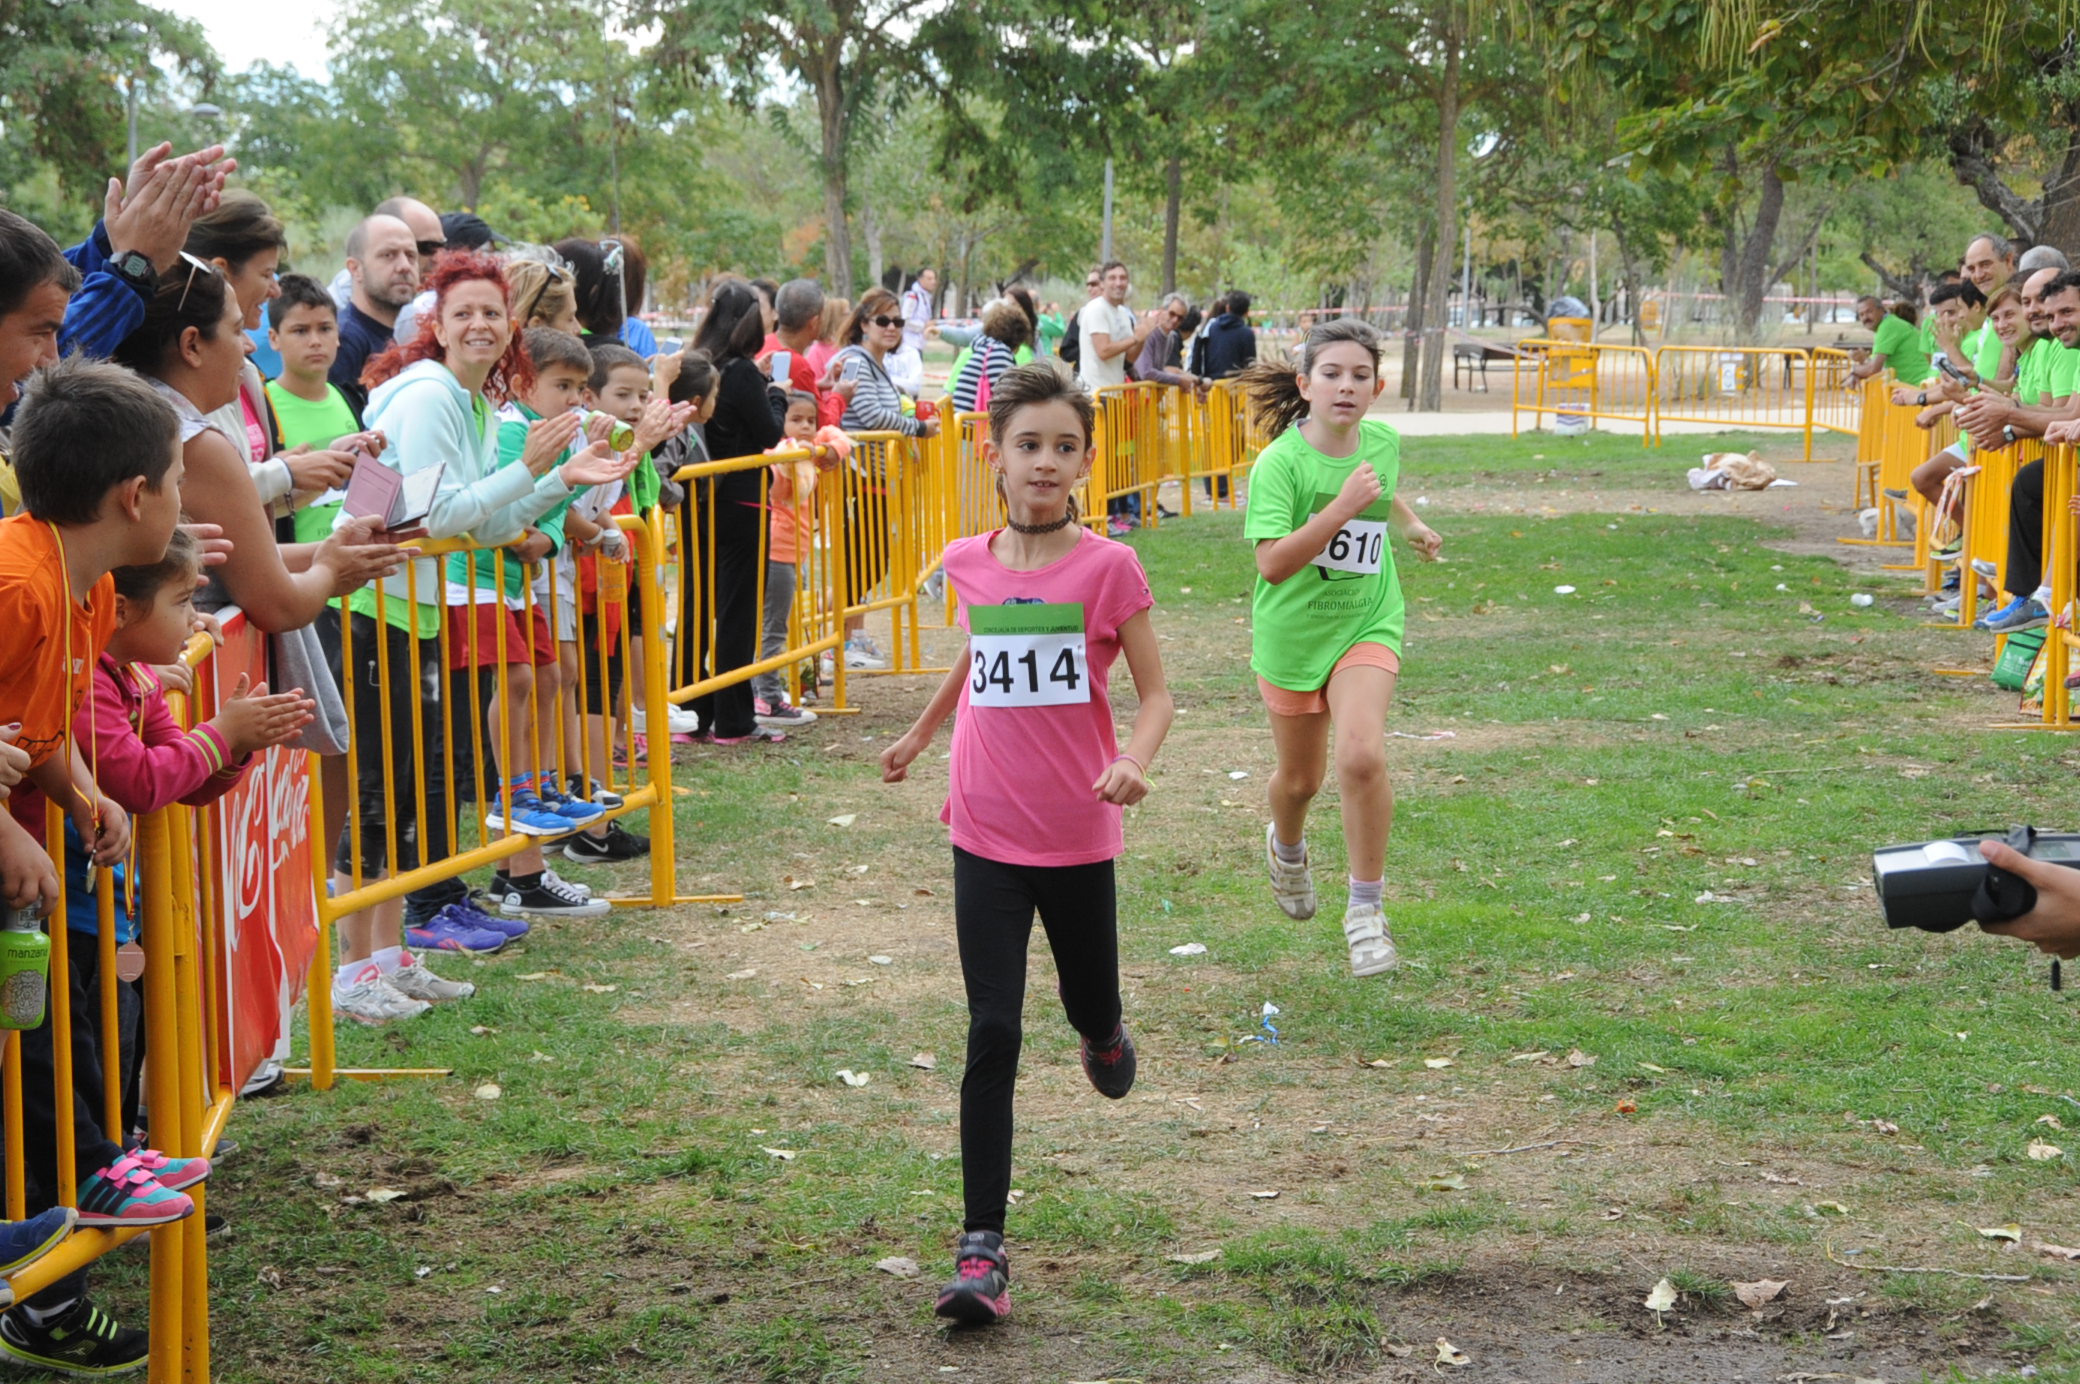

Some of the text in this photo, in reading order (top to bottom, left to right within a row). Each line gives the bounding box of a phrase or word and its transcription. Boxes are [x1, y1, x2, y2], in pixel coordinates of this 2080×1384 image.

[1317, 529, 1382, 565] 610
[1307, 597, 1372, 611] FIBROMIALGIA
[972, 648, 1081, 694] 3414
